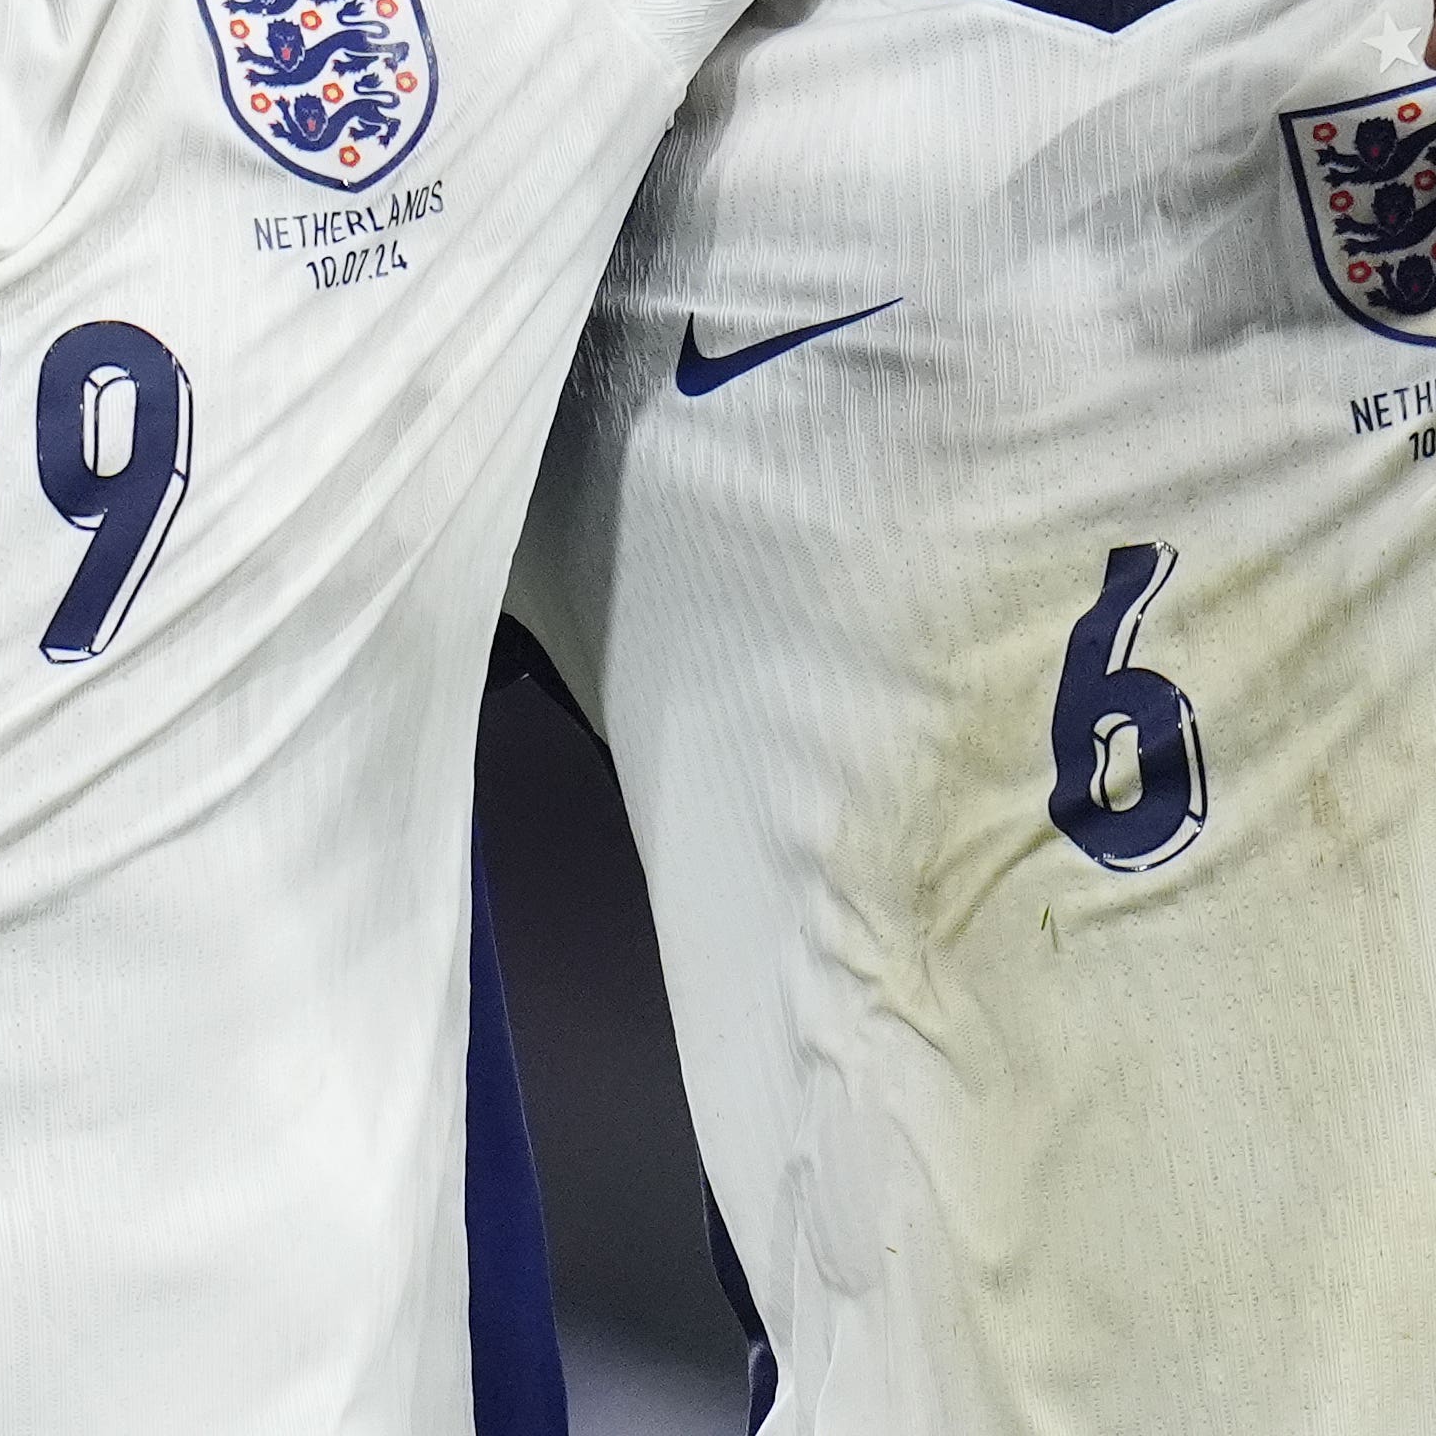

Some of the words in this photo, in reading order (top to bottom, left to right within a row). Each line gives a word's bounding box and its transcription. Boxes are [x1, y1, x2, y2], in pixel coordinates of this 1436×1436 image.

[253, 180, 444, 251] NETHERLANDS
[306, 240, 408, 290] 10.07.24
[1048, 540, 1208, 873] 6
